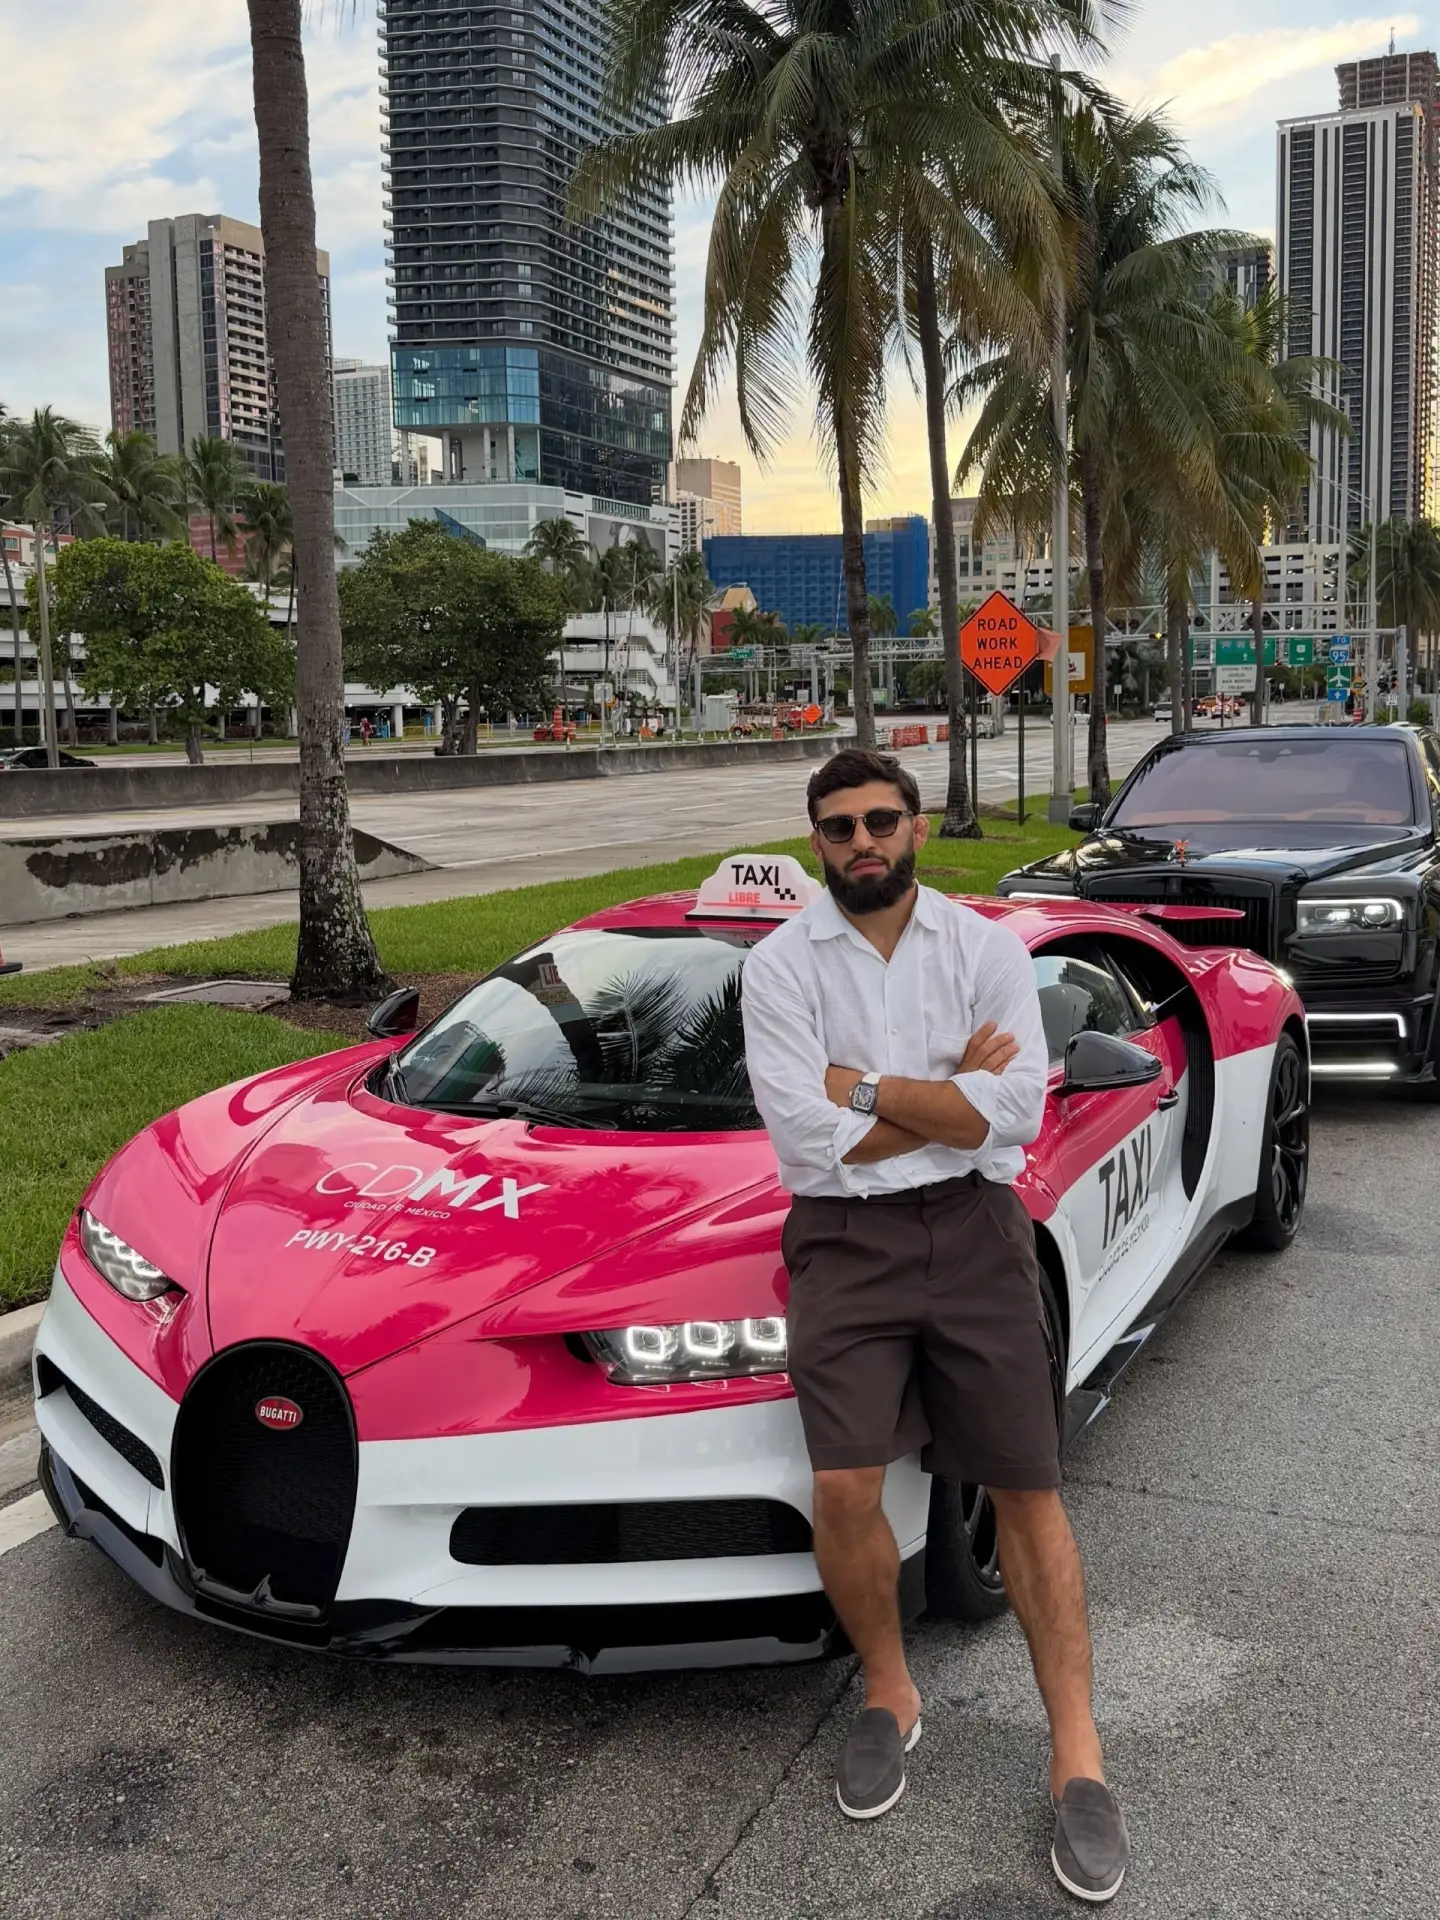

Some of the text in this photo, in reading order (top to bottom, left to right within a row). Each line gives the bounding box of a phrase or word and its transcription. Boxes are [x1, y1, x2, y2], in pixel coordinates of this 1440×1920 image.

[977, 617, 1018, 631] ROAD
[976, 636, 1018, 650] WORK
[973, 656, 1023, 670] AHEAD
[1332, 651, 1346, 662] 95
[731, 864, 779, 886] TAXI
[728, 891, 761, 904] LIBRE
[315, 1161, 551, 1219] CDMX
[1098, 1123, 1152, 1251] TAXI
[343, 1200, 387, 1212] CIUDAD
[404, 1206, 451, 1219] MÉXICO
[284, 1229, 437, 1268] PWY-216-B
[260, 1405, 297, 1423] BUGATTI
